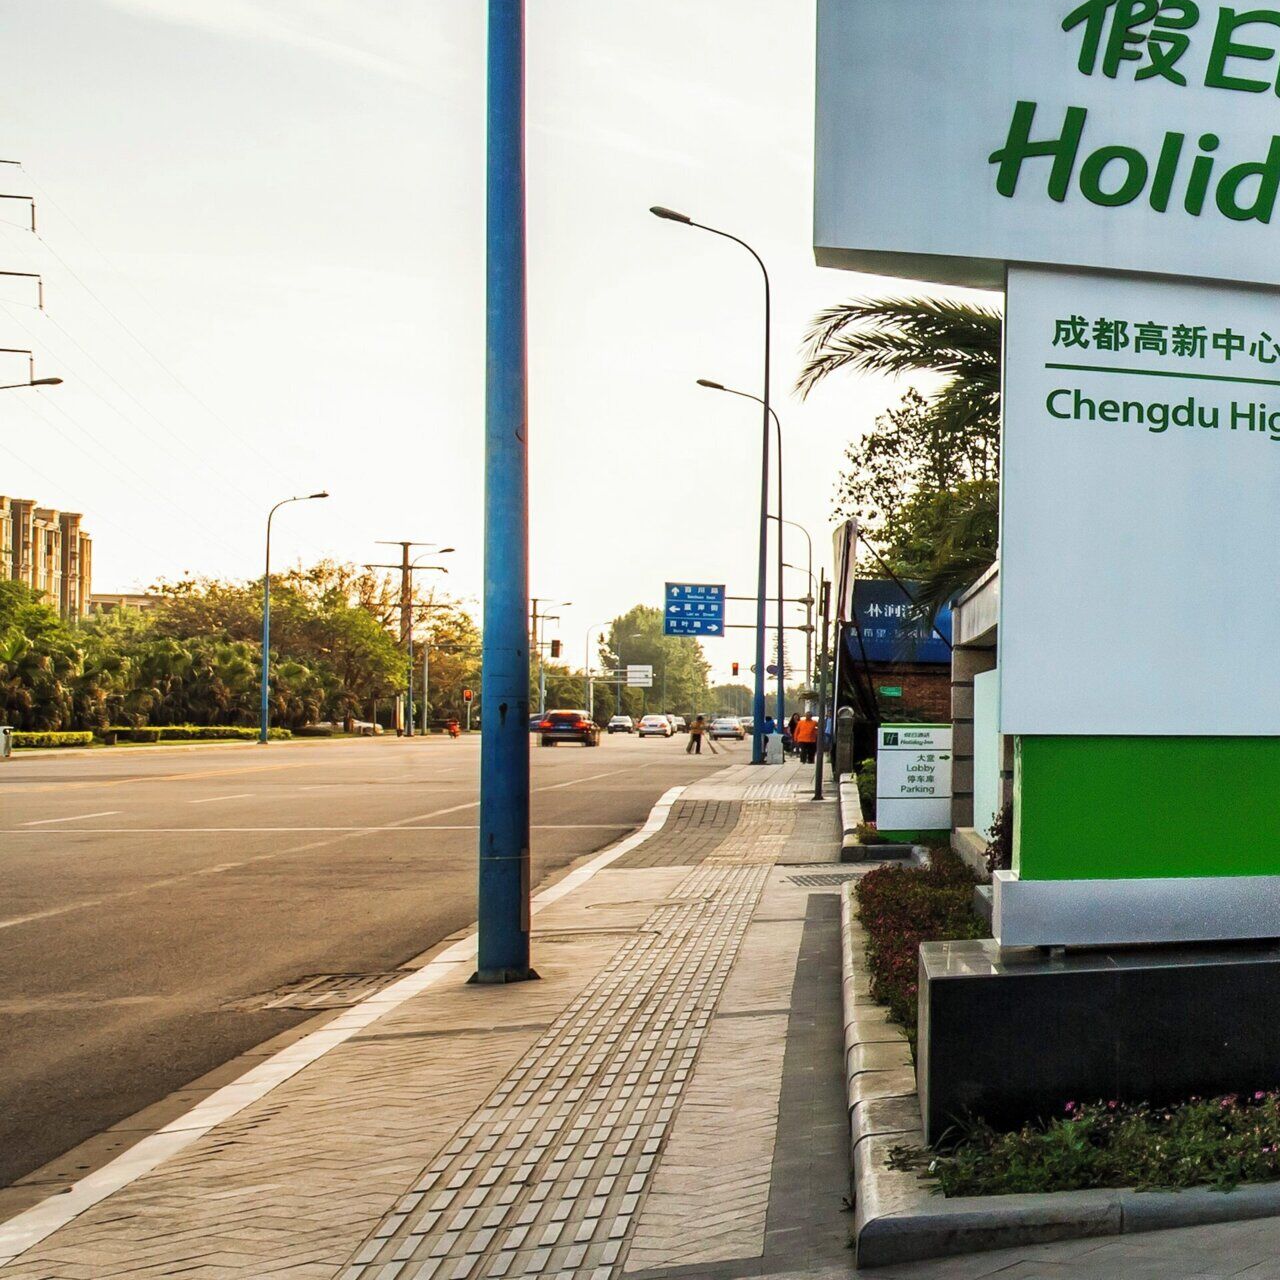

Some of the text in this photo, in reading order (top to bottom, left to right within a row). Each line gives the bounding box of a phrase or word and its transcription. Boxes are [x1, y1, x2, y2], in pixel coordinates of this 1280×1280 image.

[1046, 389, 1219, 433] Chengdu
[917, 754, 935, 762] 大堂
[907, 764, 935, 773] Lobby
[901, 785, 935, 794] Parking
